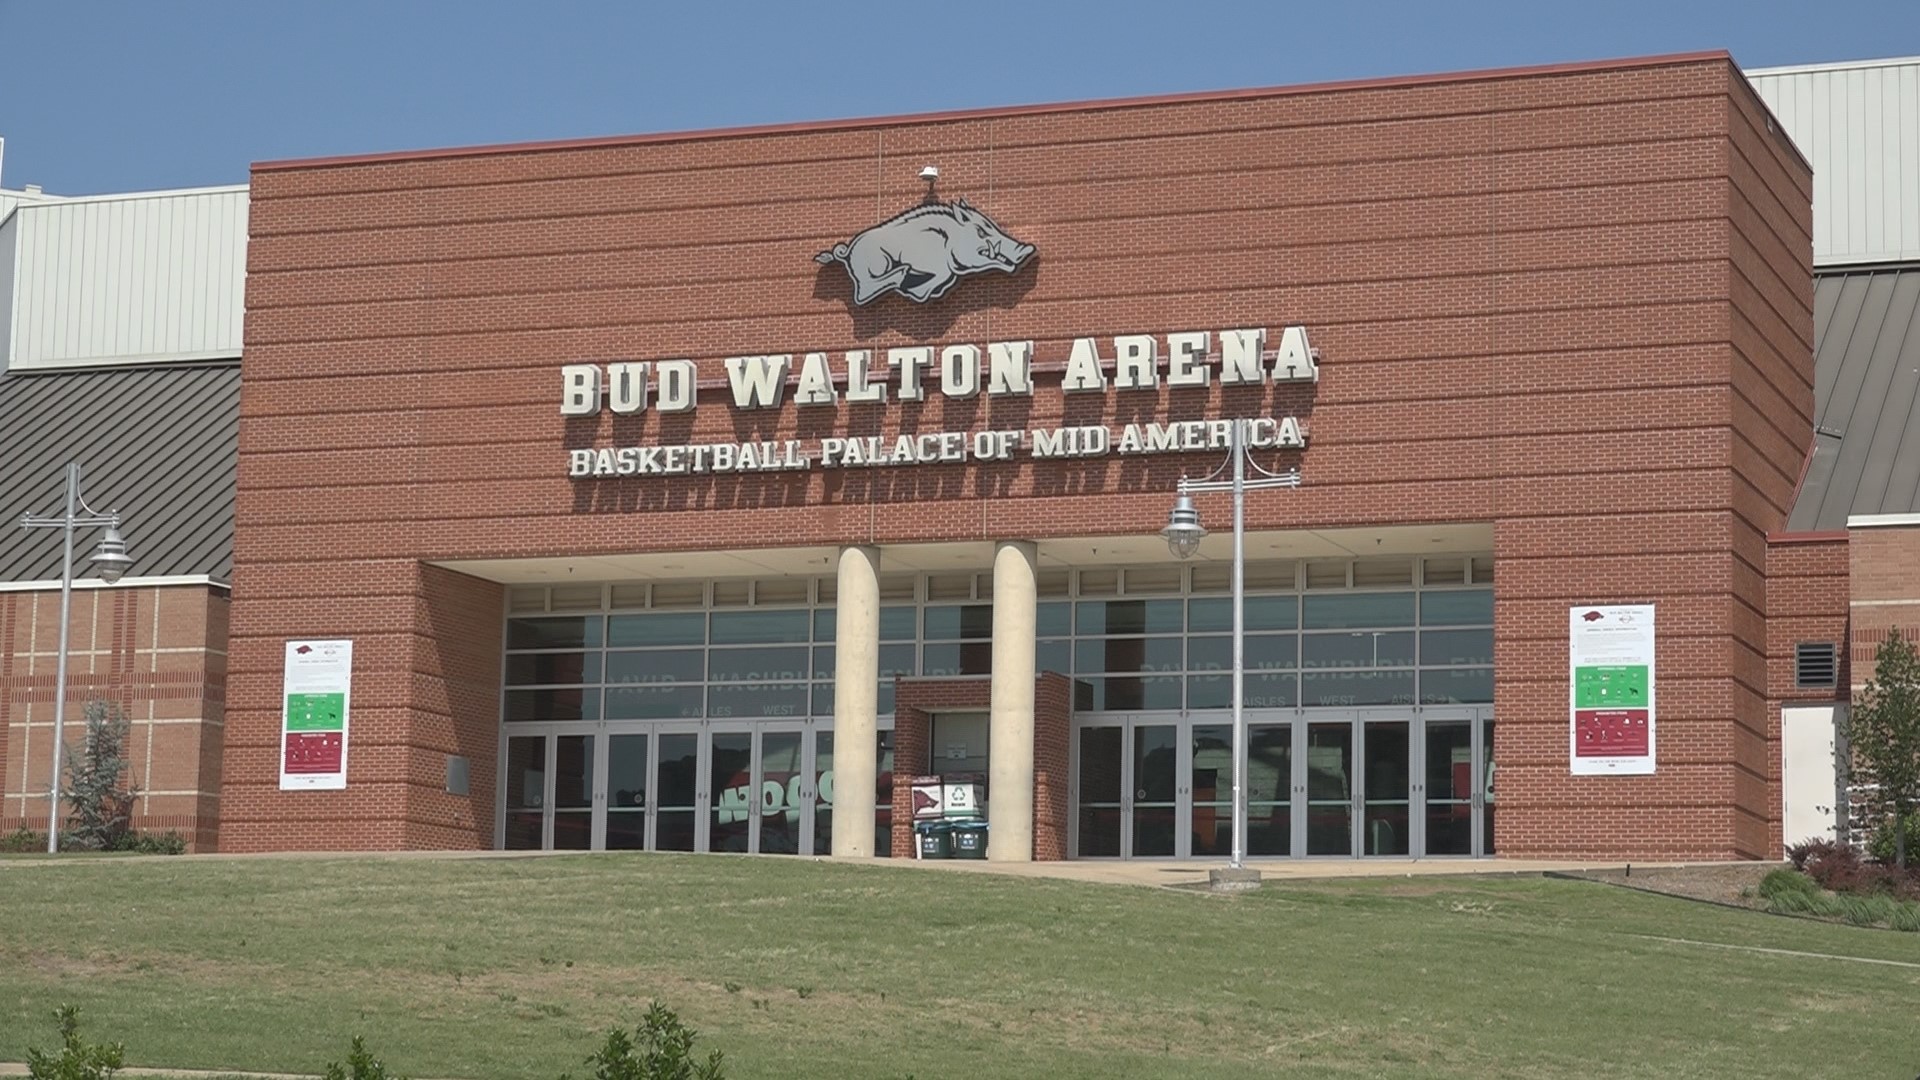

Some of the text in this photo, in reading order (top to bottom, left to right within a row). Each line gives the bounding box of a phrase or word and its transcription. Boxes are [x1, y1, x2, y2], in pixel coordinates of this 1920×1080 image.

[560, 326, 1319, 416] BUD WALTON ARENA
[569, 440, 811, 477] BASKETBALL
[820, 432, 967, 467] PALACE
[973, 430, 1025, 461] OF
[1031, 425, 1110, 459] MID
[692, 703, 795, 717] AILES WEST
[1319, 694, 1356, 706] WEST
